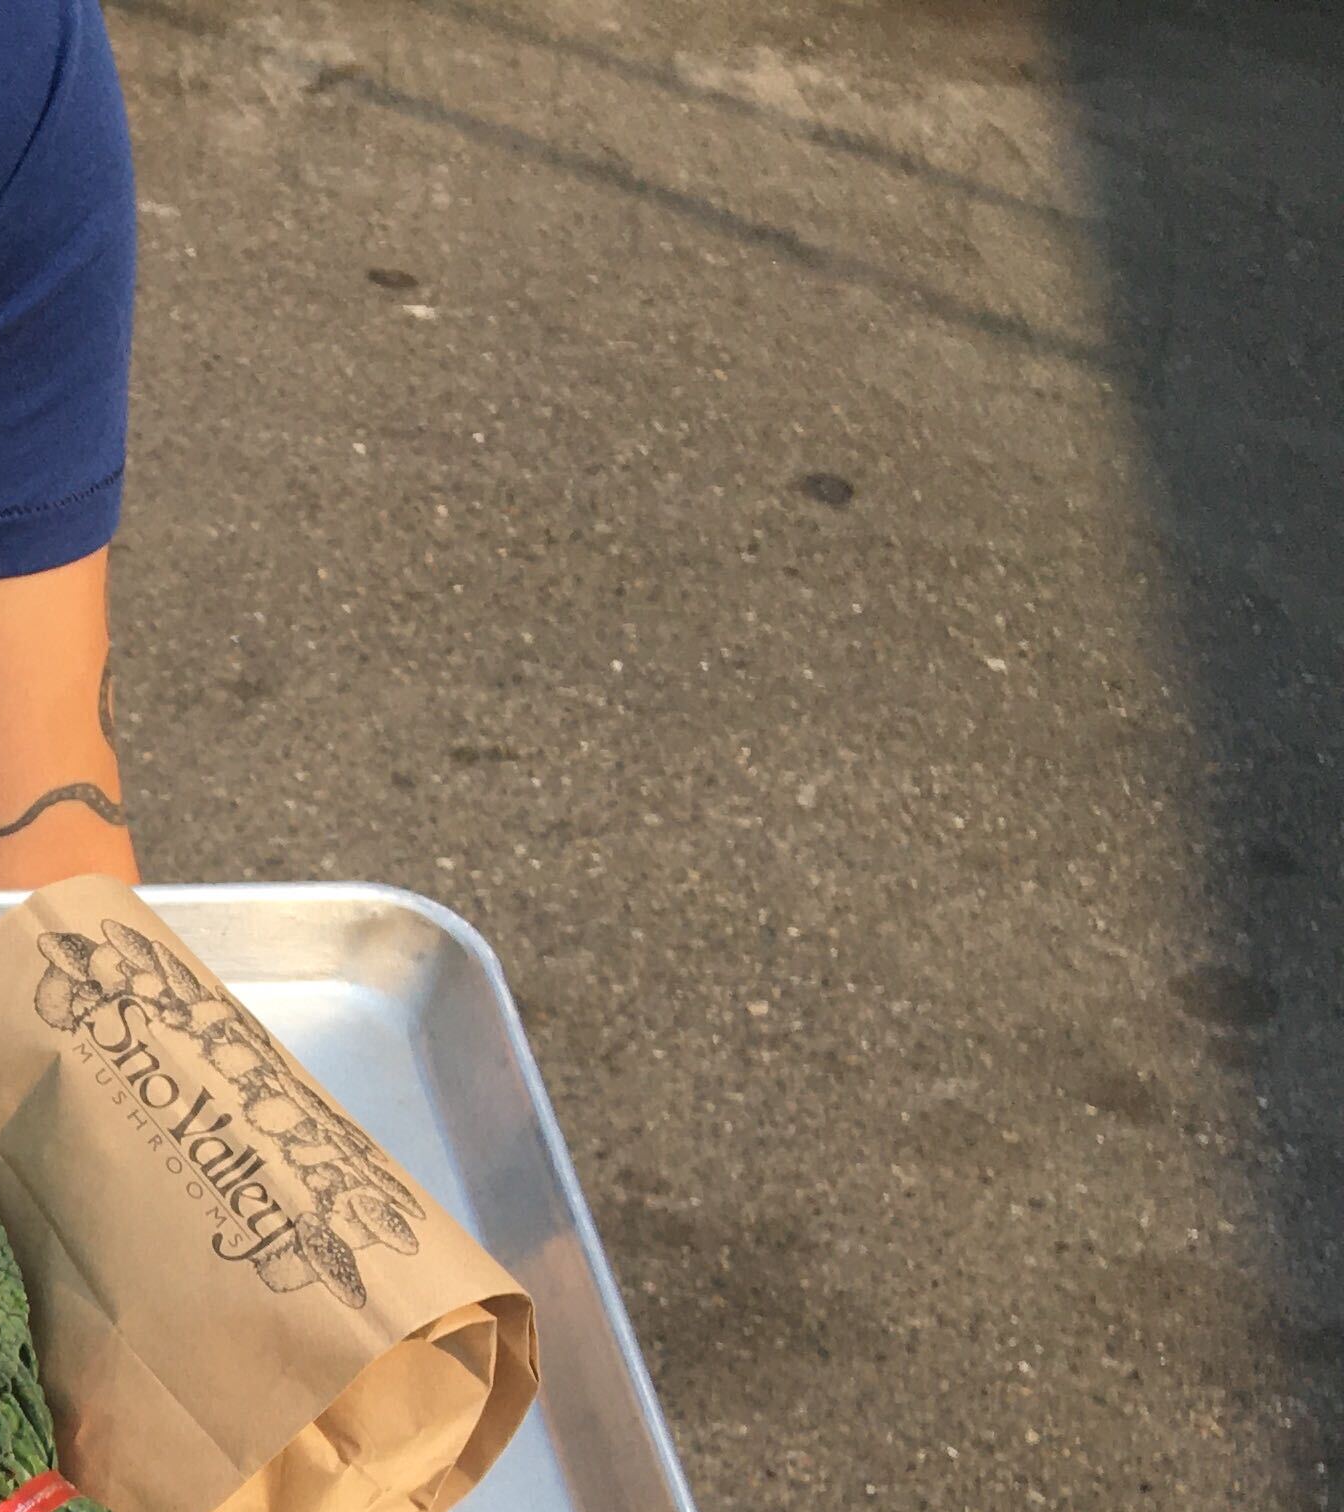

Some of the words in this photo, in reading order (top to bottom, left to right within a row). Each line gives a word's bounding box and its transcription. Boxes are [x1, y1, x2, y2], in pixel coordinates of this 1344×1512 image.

[72, 1042, 244, 1249] MUSHROOMS
[84, 998, 180, 1109] Sno
[166, 1086, 296, 1261] Valley
